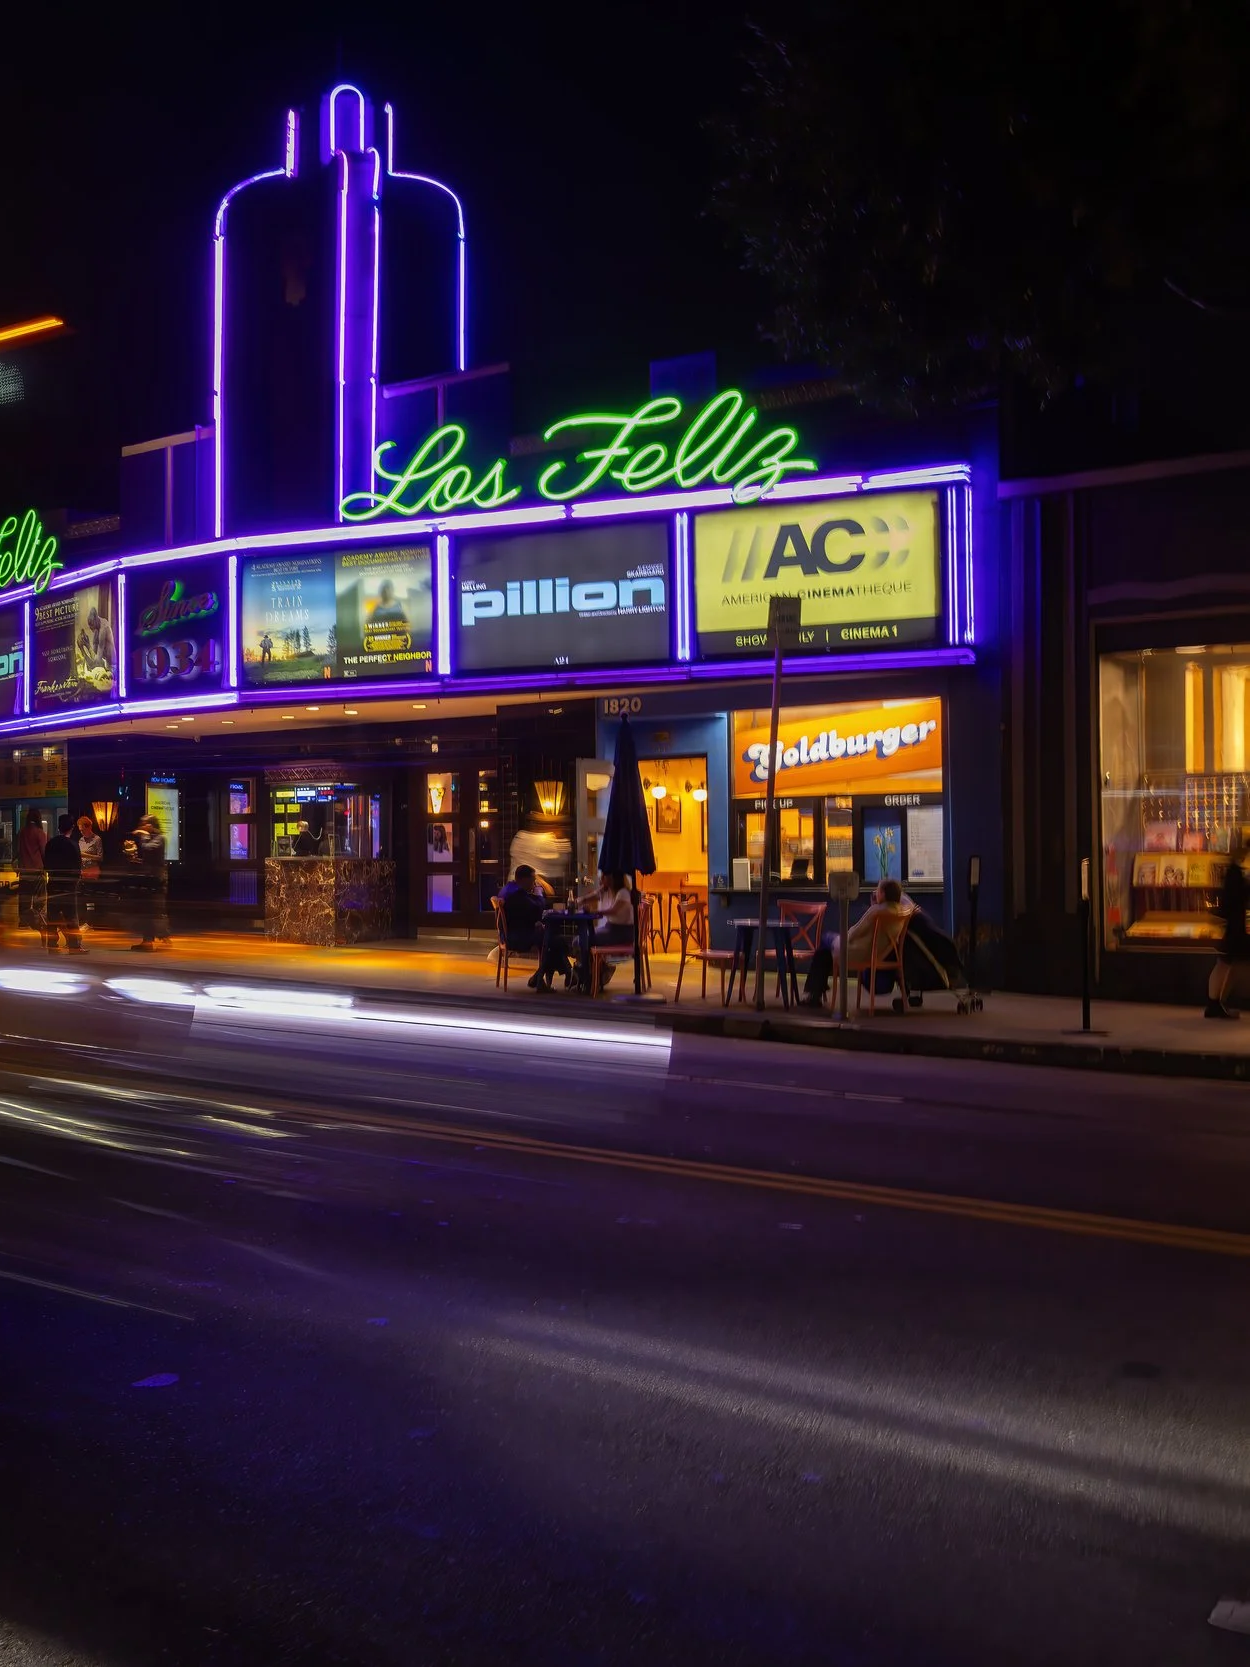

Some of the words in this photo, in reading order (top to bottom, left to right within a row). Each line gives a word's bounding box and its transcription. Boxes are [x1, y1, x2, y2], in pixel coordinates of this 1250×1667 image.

[340, 424, 521, 521] Los
[538, 389, 818, 503] Feliz
[763, 518, 866, 579] AC
[798, 581, 913, 600] CINEMATHEQUE
[271, 595, 303, 609] TRAIN
[461, 577, 665, 627] pillion
[265, 609, 309, 624] DREAMS
[840, 625, 890, 641] CINEMA
[132, 639, 222, 681] 1934
[343, 655, 358, 665] THE
[359, 653, 391, 664] PERFECT
[393, 650, 432, 661] NEIGHBOR
[604, 696, 642, 714] 1820
[745, 719, 937, 781] Goldburger
[779, 798, 793, 809] UP
[884, 794, 921, 807] ORDER
